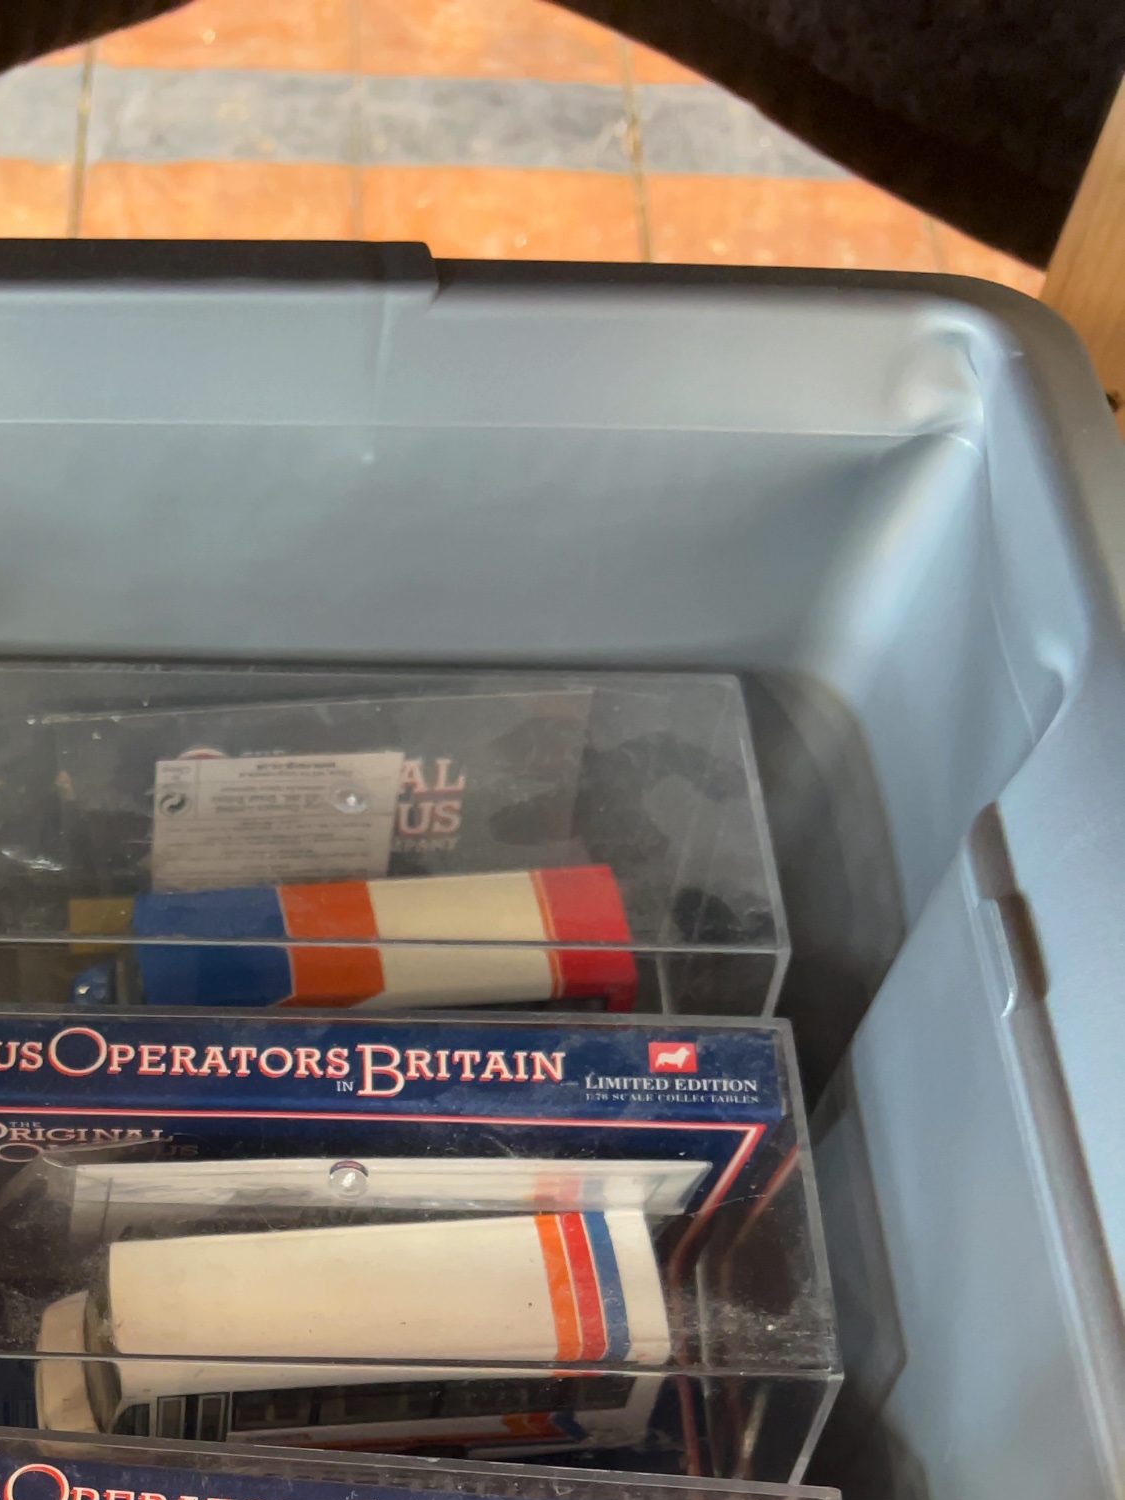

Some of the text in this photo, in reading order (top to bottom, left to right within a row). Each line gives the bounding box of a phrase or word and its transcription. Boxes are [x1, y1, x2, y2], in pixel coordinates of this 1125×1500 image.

[48, 1026, 352, 1079] OPERATORS
[336, 1081, 354, 1093] IN
[356, 1043, 566, 1098] BRITAIN
[585, 1075, 758, 1093] LIMITED EDITION
[612, 1093, 654, 1103] SCALE
[657, 1094, 760, 1105] COLLECTABLES
